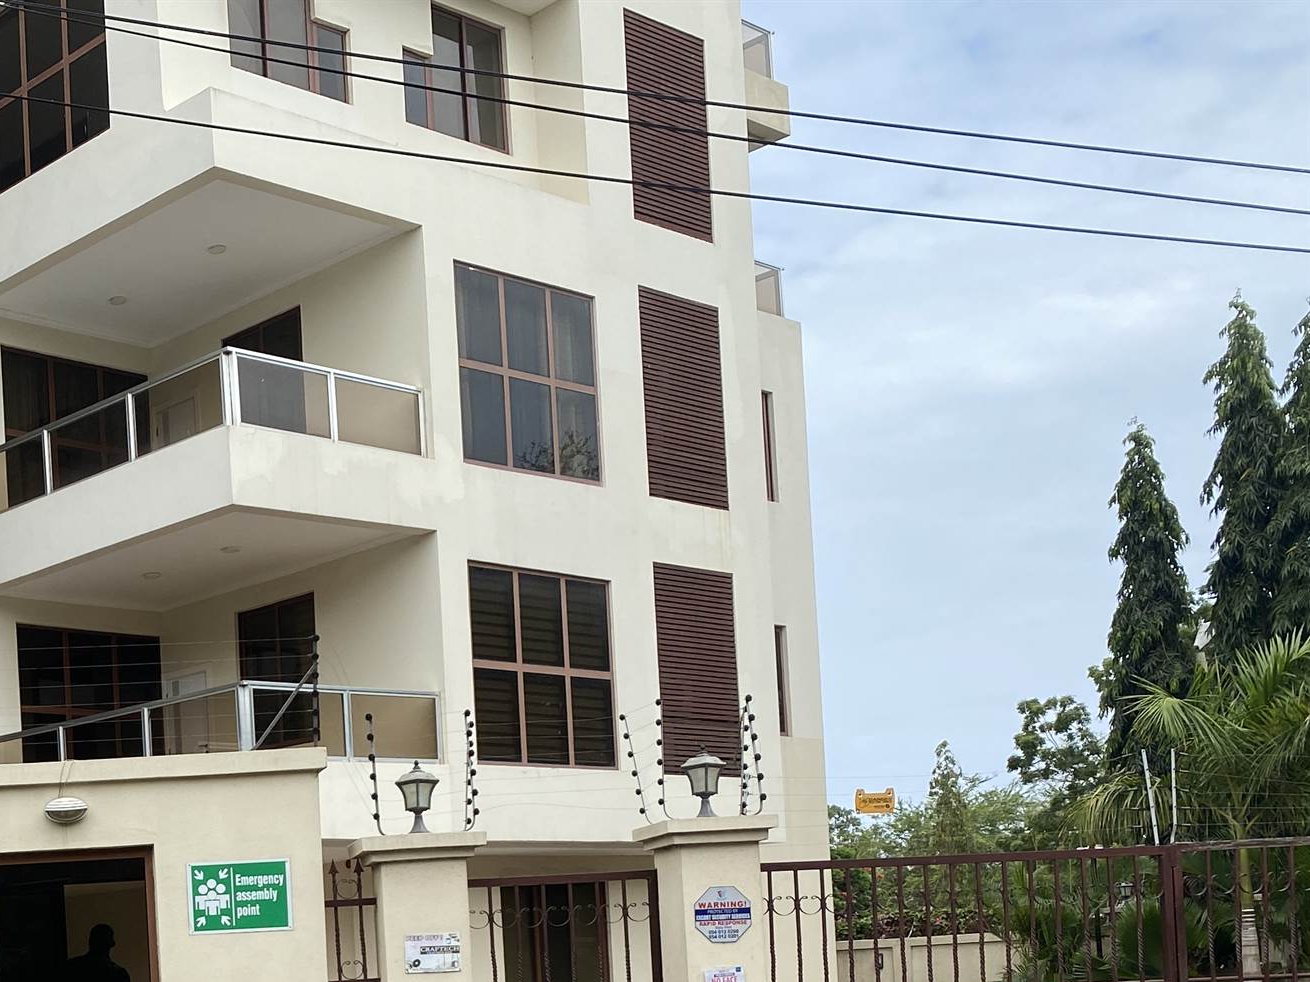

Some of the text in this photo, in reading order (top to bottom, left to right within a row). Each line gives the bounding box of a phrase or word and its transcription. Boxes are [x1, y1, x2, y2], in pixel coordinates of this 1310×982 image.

[235, 874, 284, 887] Emergency
[236, 888, 277, 902] assembly
[698, 900, 747, 909] WARNING!
[236, 904, 260, 919] point
